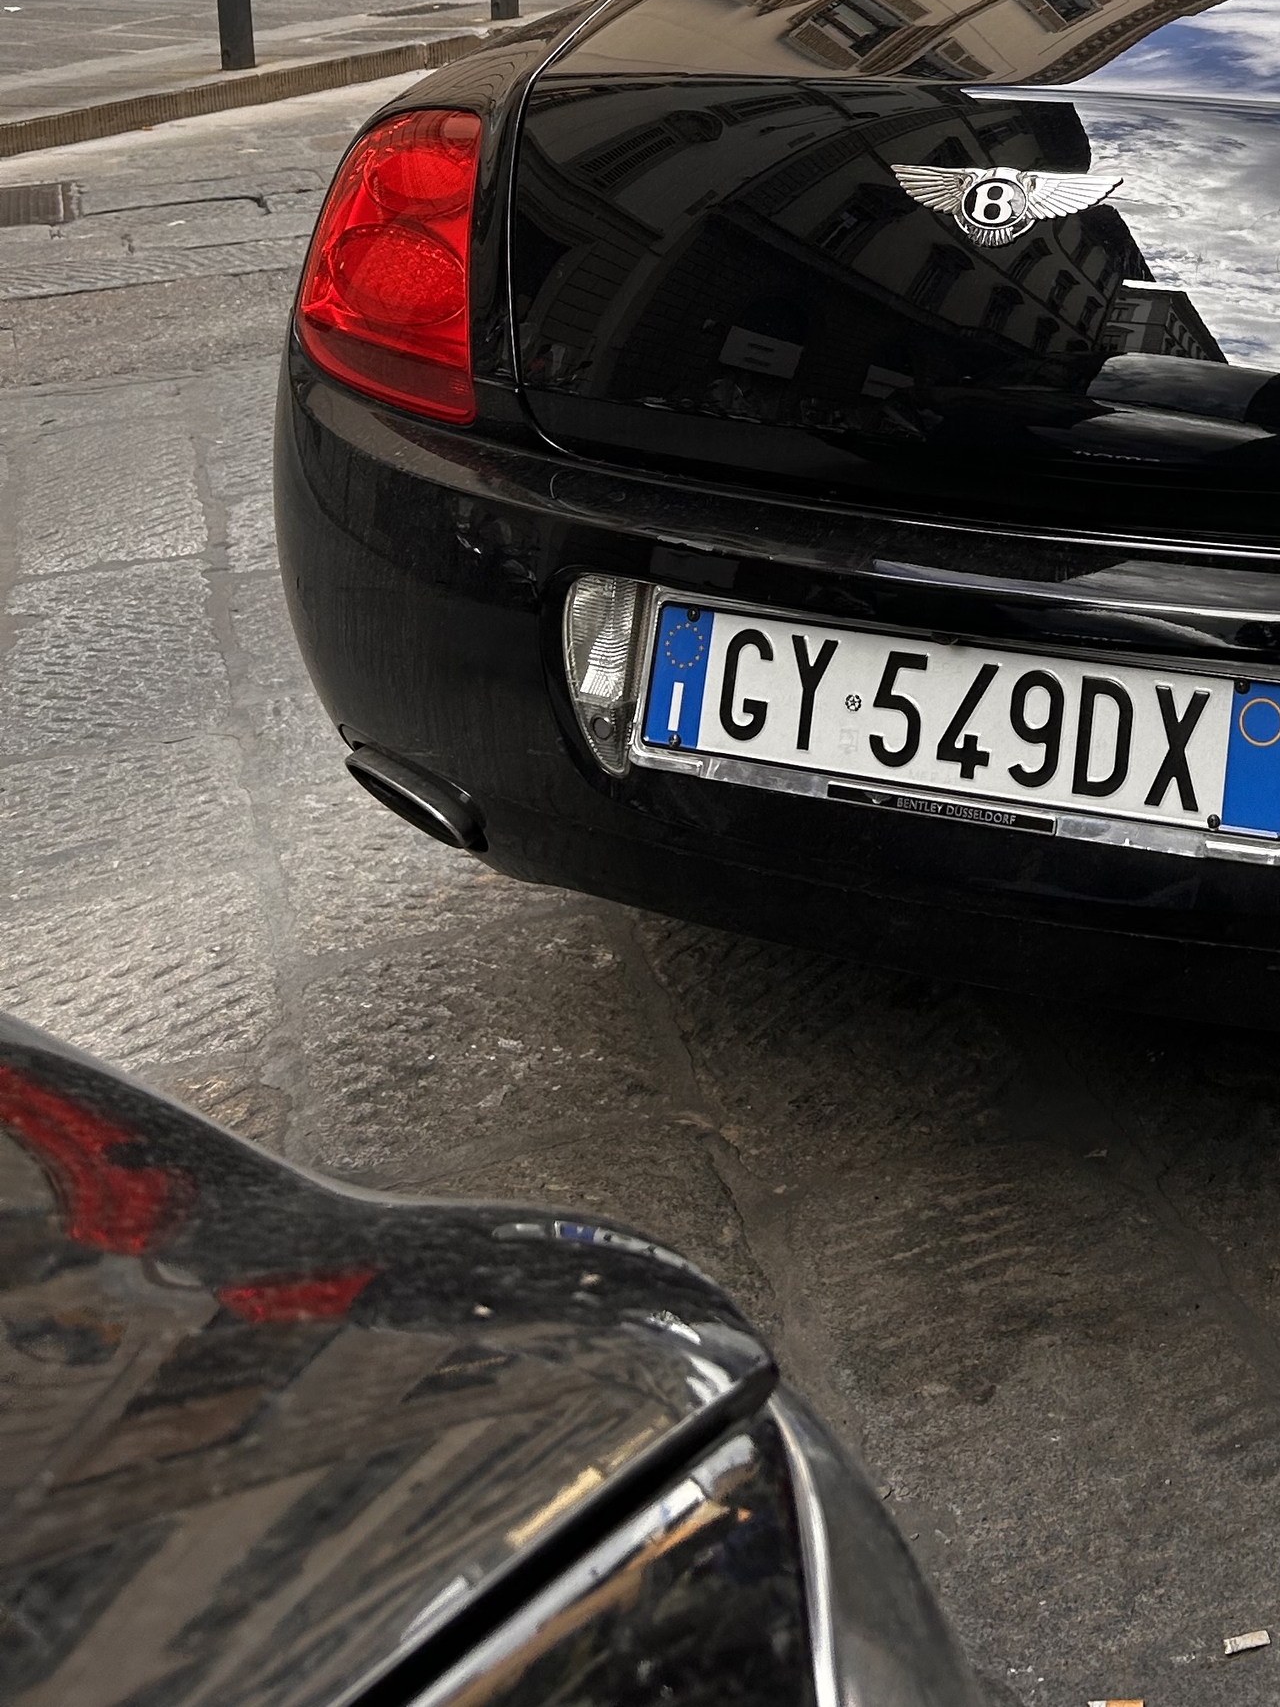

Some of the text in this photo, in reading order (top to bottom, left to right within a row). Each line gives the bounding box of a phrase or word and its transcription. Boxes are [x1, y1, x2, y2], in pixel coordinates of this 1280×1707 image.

[971, 182, 1015, 225] B
[719, 628, 1211, 812] GY 549DX
[896, 797, 1016, 825] BENTLEY DÜSSELDORF
